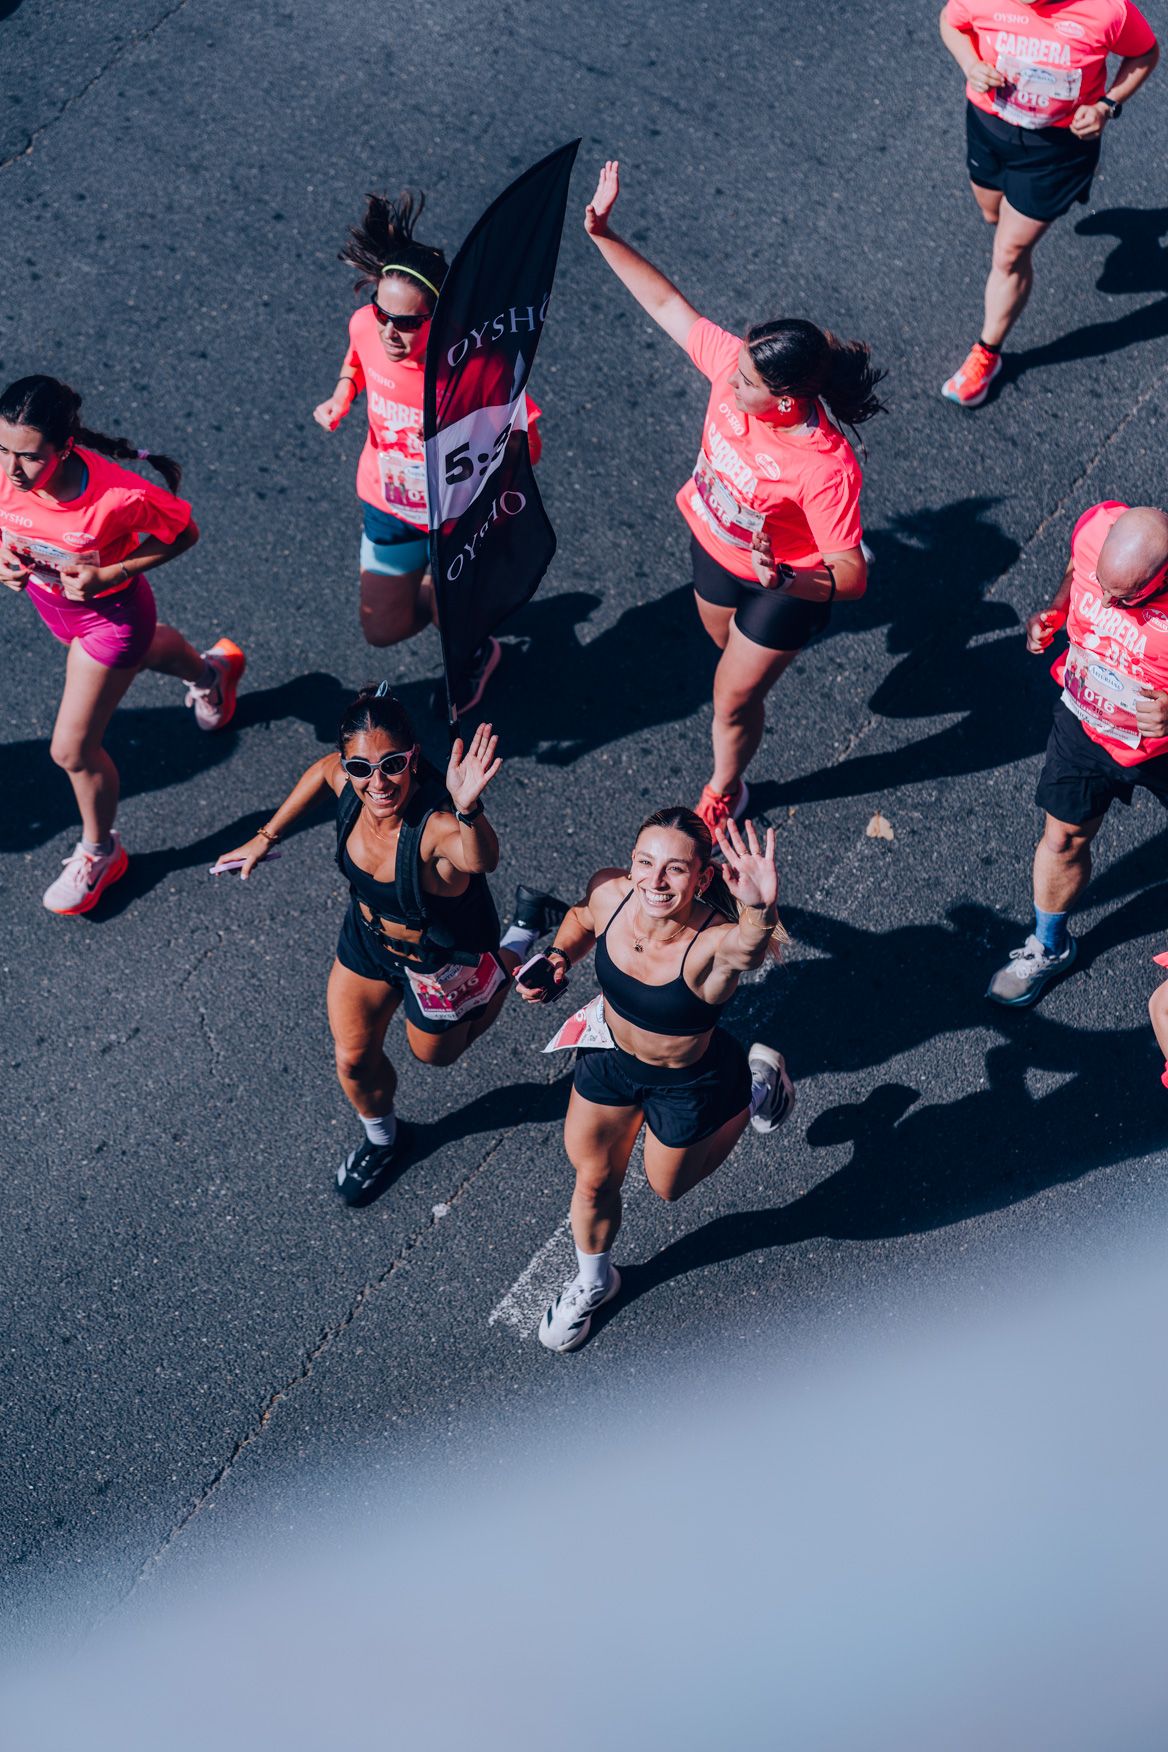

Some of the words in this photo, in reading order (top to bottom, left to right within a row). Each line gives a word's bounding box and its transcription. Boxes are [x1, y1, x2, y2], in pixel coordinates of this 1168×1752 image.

[995, 31, 1071, 67] CARRERA
[719, 402, 745, 436] OYSHO
[1079, 591, 1147, 659] CARRERA
[1084, 688, 1116, 714] 016
